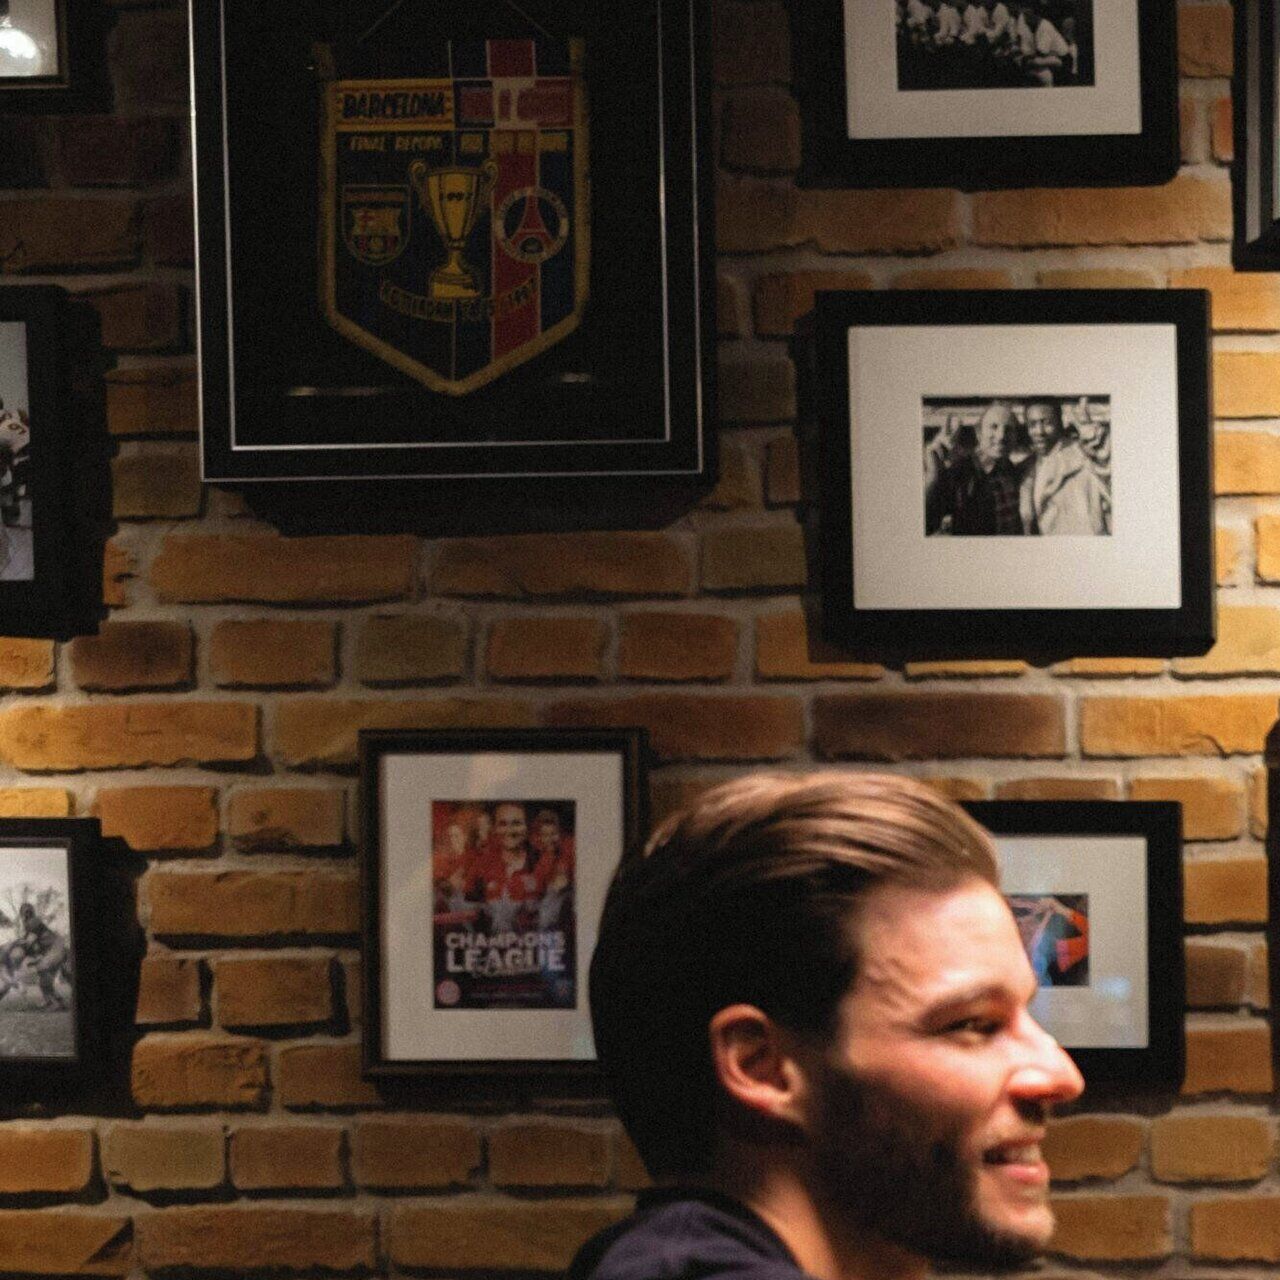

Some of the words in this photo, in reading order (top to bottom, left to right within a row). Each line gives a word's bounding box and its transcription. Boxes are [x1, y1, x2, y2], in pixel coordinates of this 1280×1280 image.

[342, 92, 446, 118] BARCELONA
[445, 931, 566, 950] CHAMPIONS
[445, 948, 567, 973] LEAGUE
